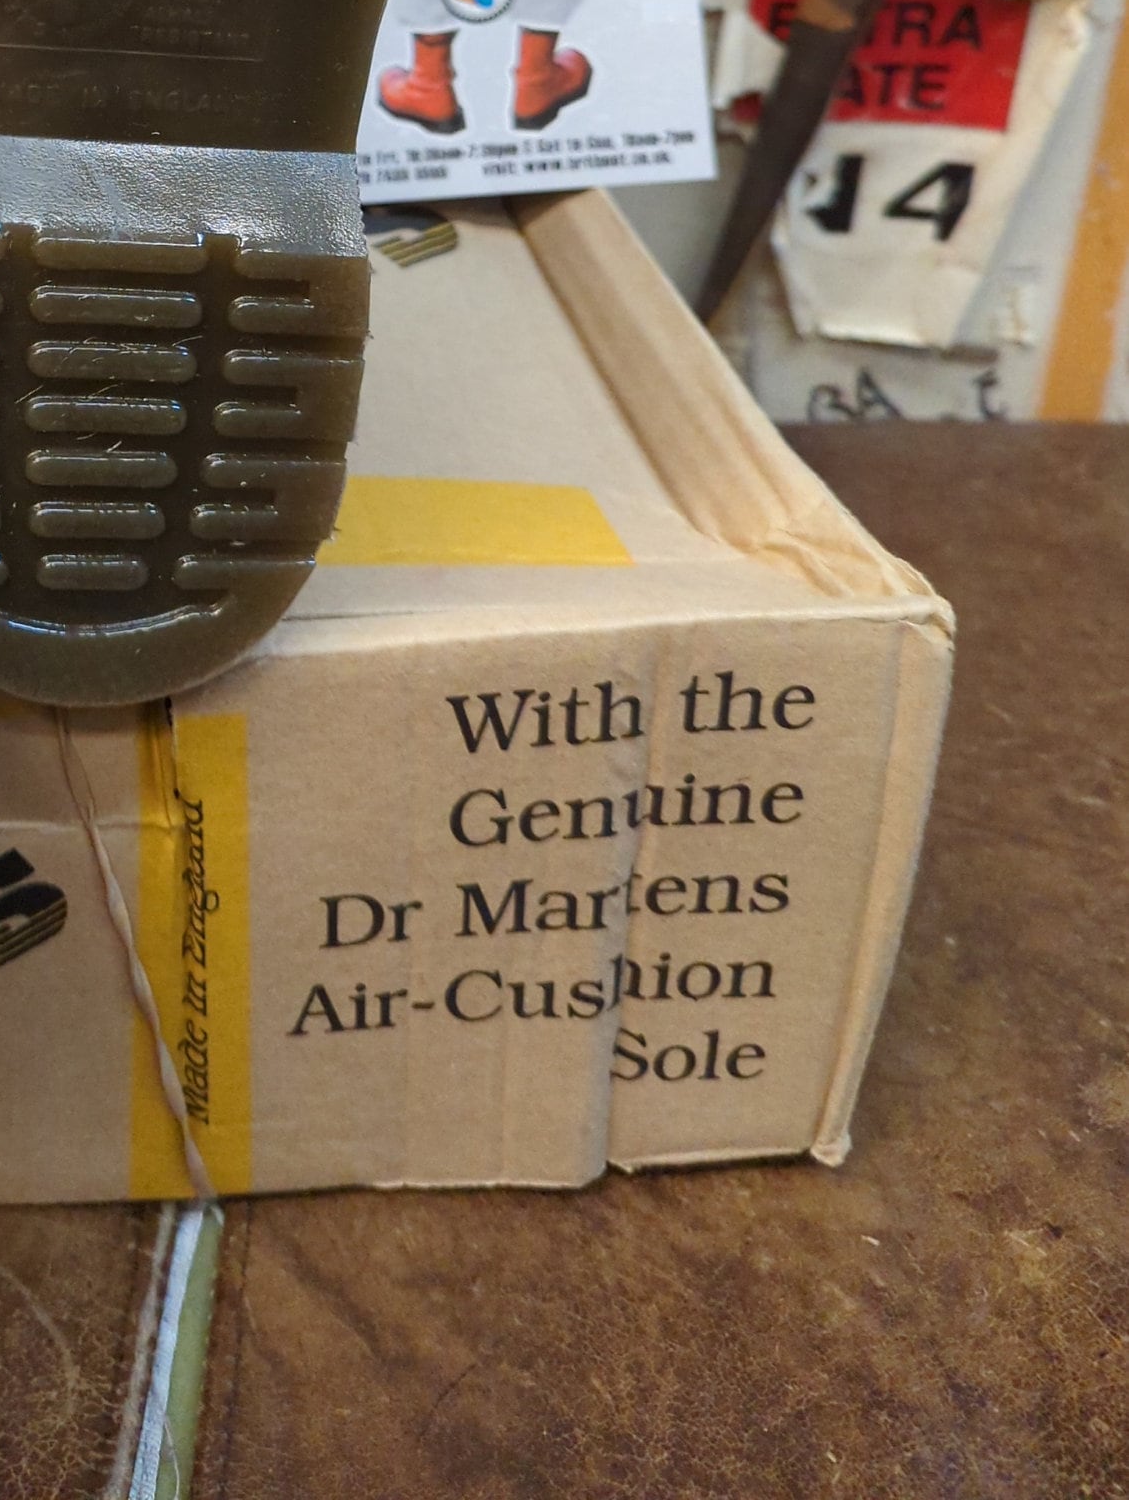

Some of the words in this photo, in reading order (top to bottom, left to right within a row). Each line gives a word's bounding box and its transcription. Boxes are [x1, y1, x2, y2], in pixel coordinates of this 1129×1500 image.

[833, 62, 952, 111] ATE
[446, 681, 644, 753] With
[678, 671, 816, 734] the
[449, 773, 806, 847] Genuine
[172, 788, 220, 970] England
[318, 892, 423, 949] Dr
[454, 871, 790, 939] Martens
[286, 953, 777, 1037] Air-Cushion
[176, 1019, 209, 1125] Made
[610, 1028, 767, 1082] Sole
